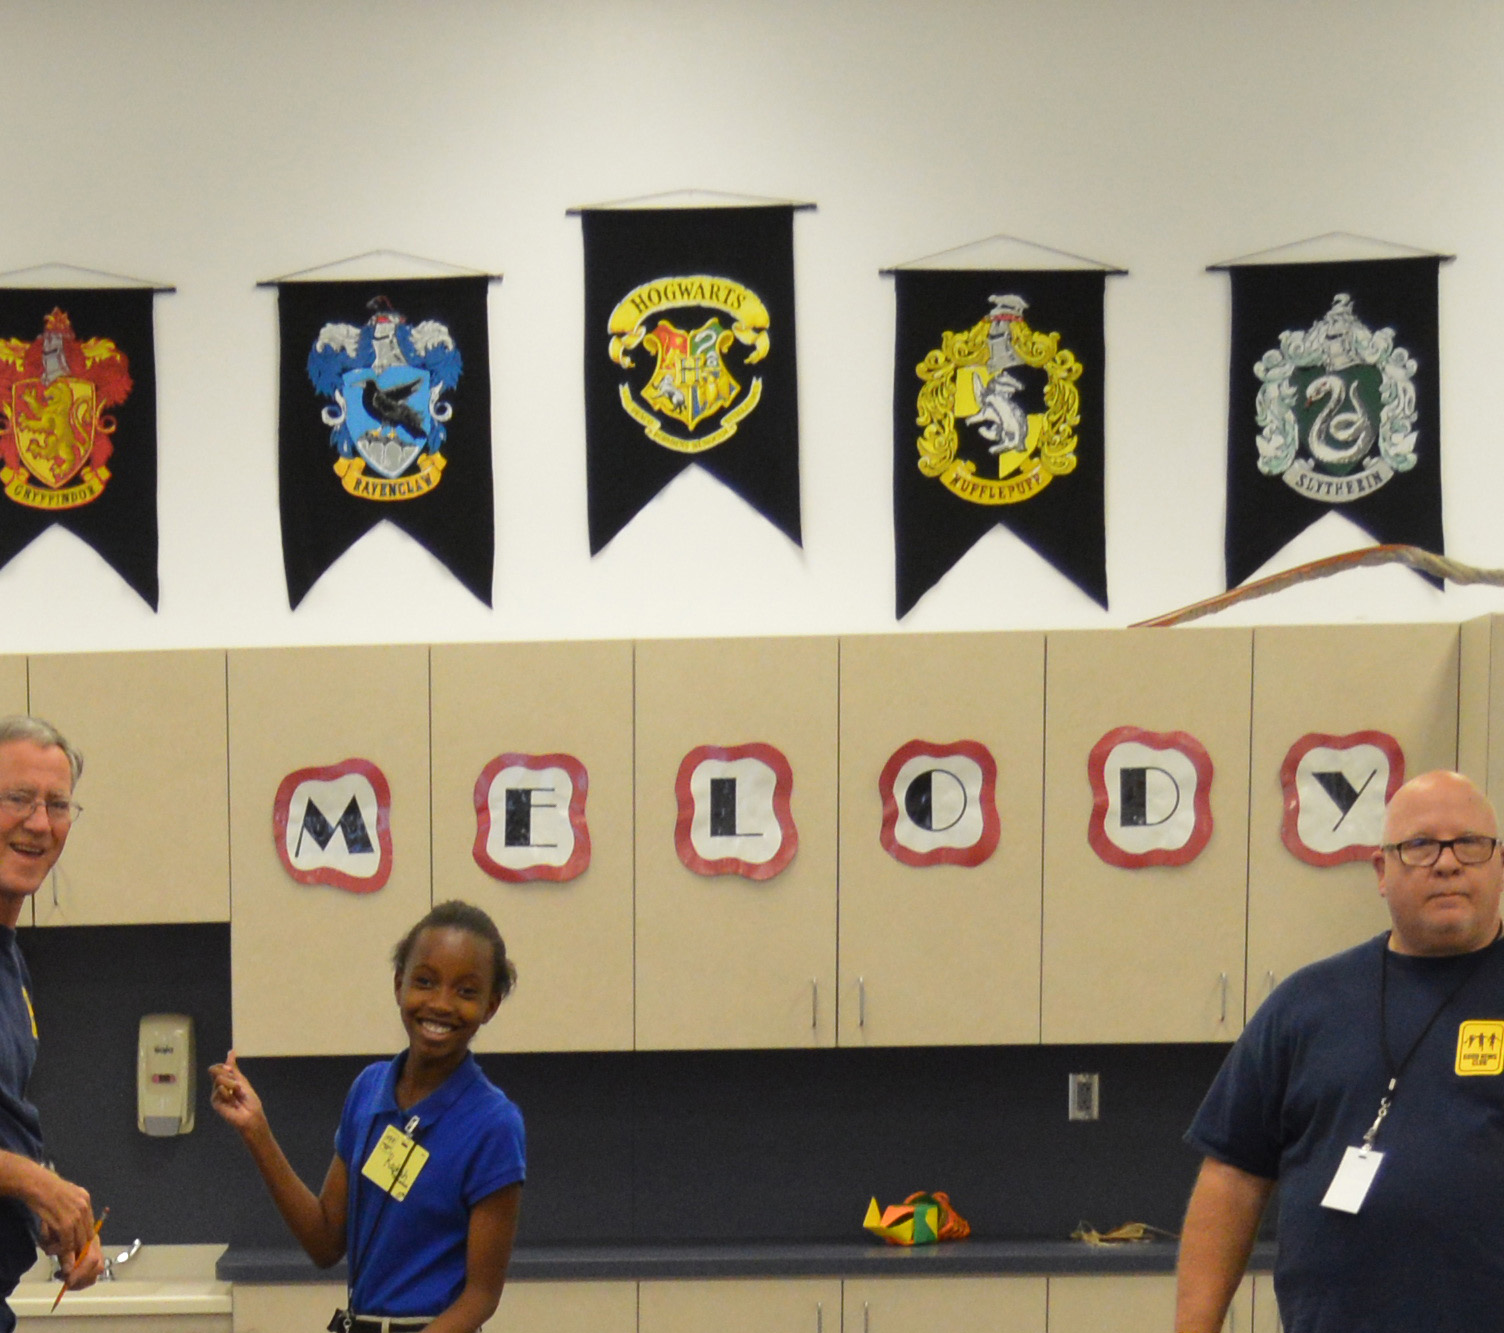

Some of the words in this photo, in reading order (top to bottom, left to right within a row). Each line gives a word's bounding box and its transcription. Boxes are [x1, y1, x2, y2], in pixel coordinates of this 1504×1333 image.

[631, 282, 747, 314] HOGWARTS
[14, 484, 95, 506] GRYFFINDOR
[354, 473, 432, 497] RAVENCLAW
[949, 473, 1042, 499] HUFFLEPUFF
[1295, 470, 1384, 496] SLYTHERIN
